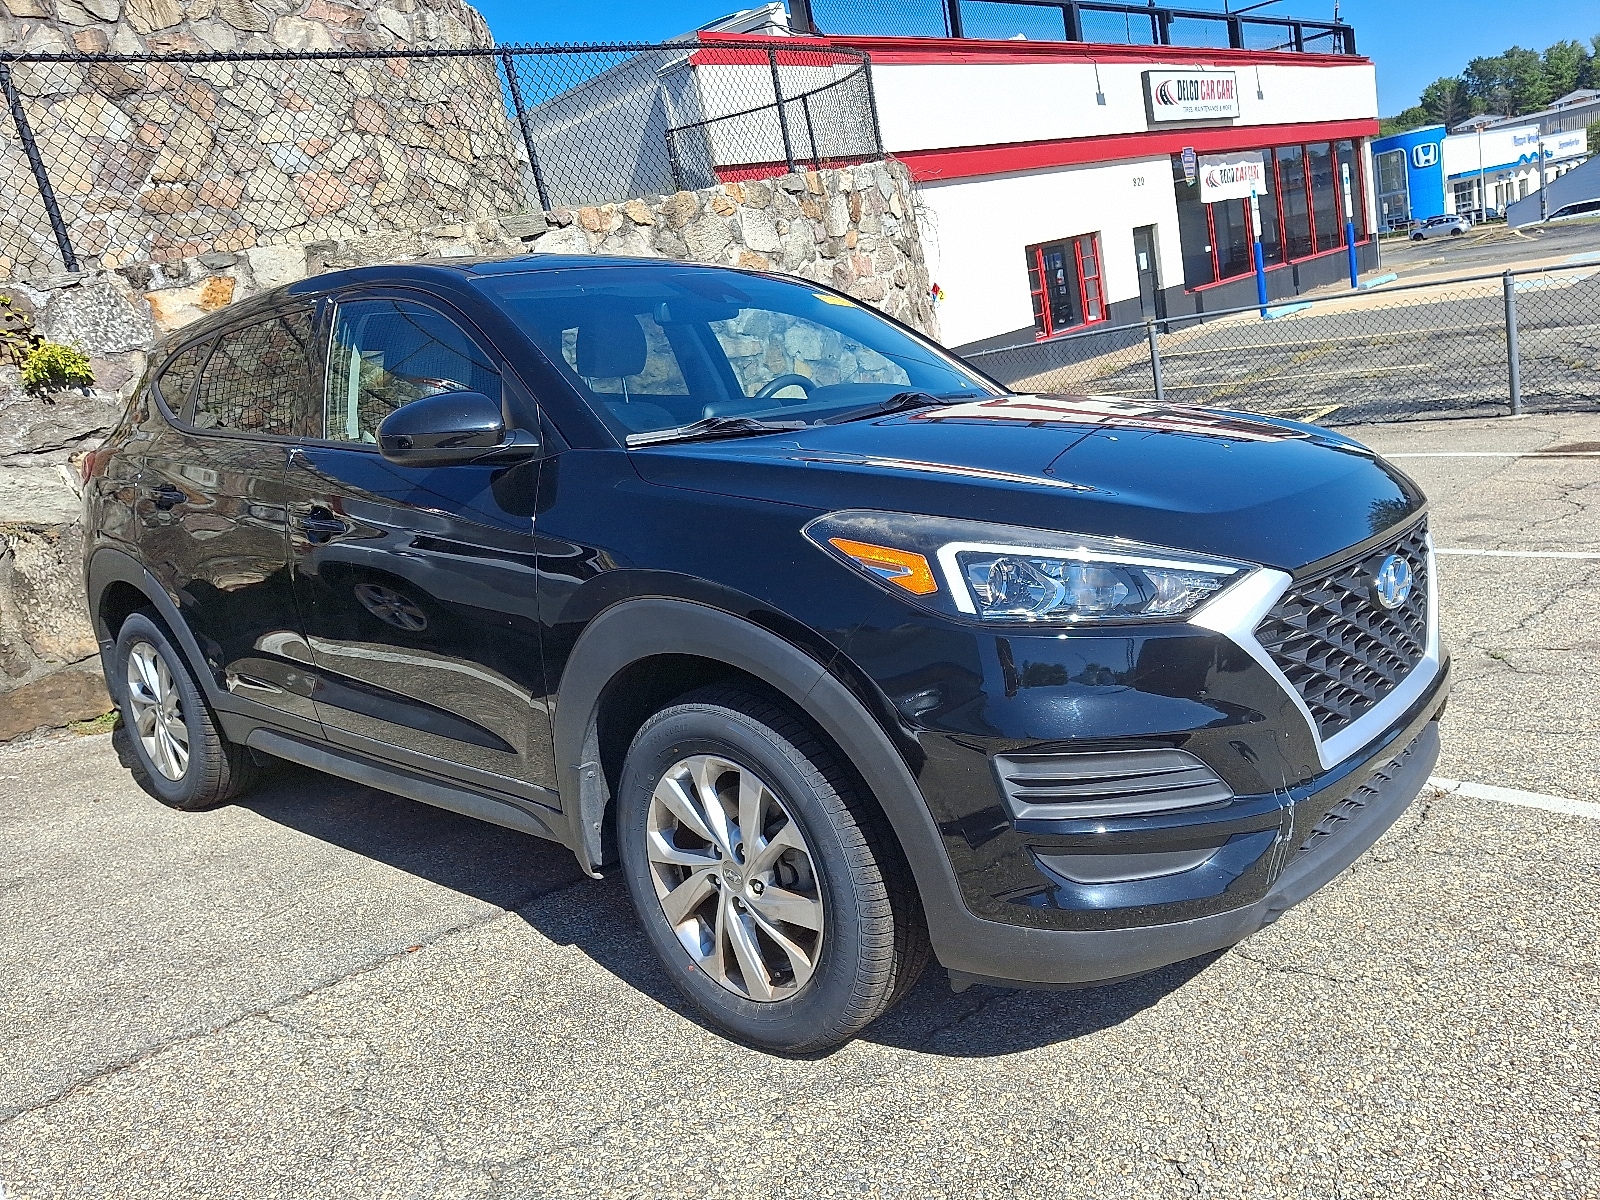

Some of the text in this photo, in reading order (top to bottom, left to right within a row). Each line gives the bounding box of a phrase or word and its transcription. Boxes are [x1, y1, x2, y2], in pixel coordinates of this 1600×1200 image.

[1177, 80, 1234, 101] DELCO CAR CARE
